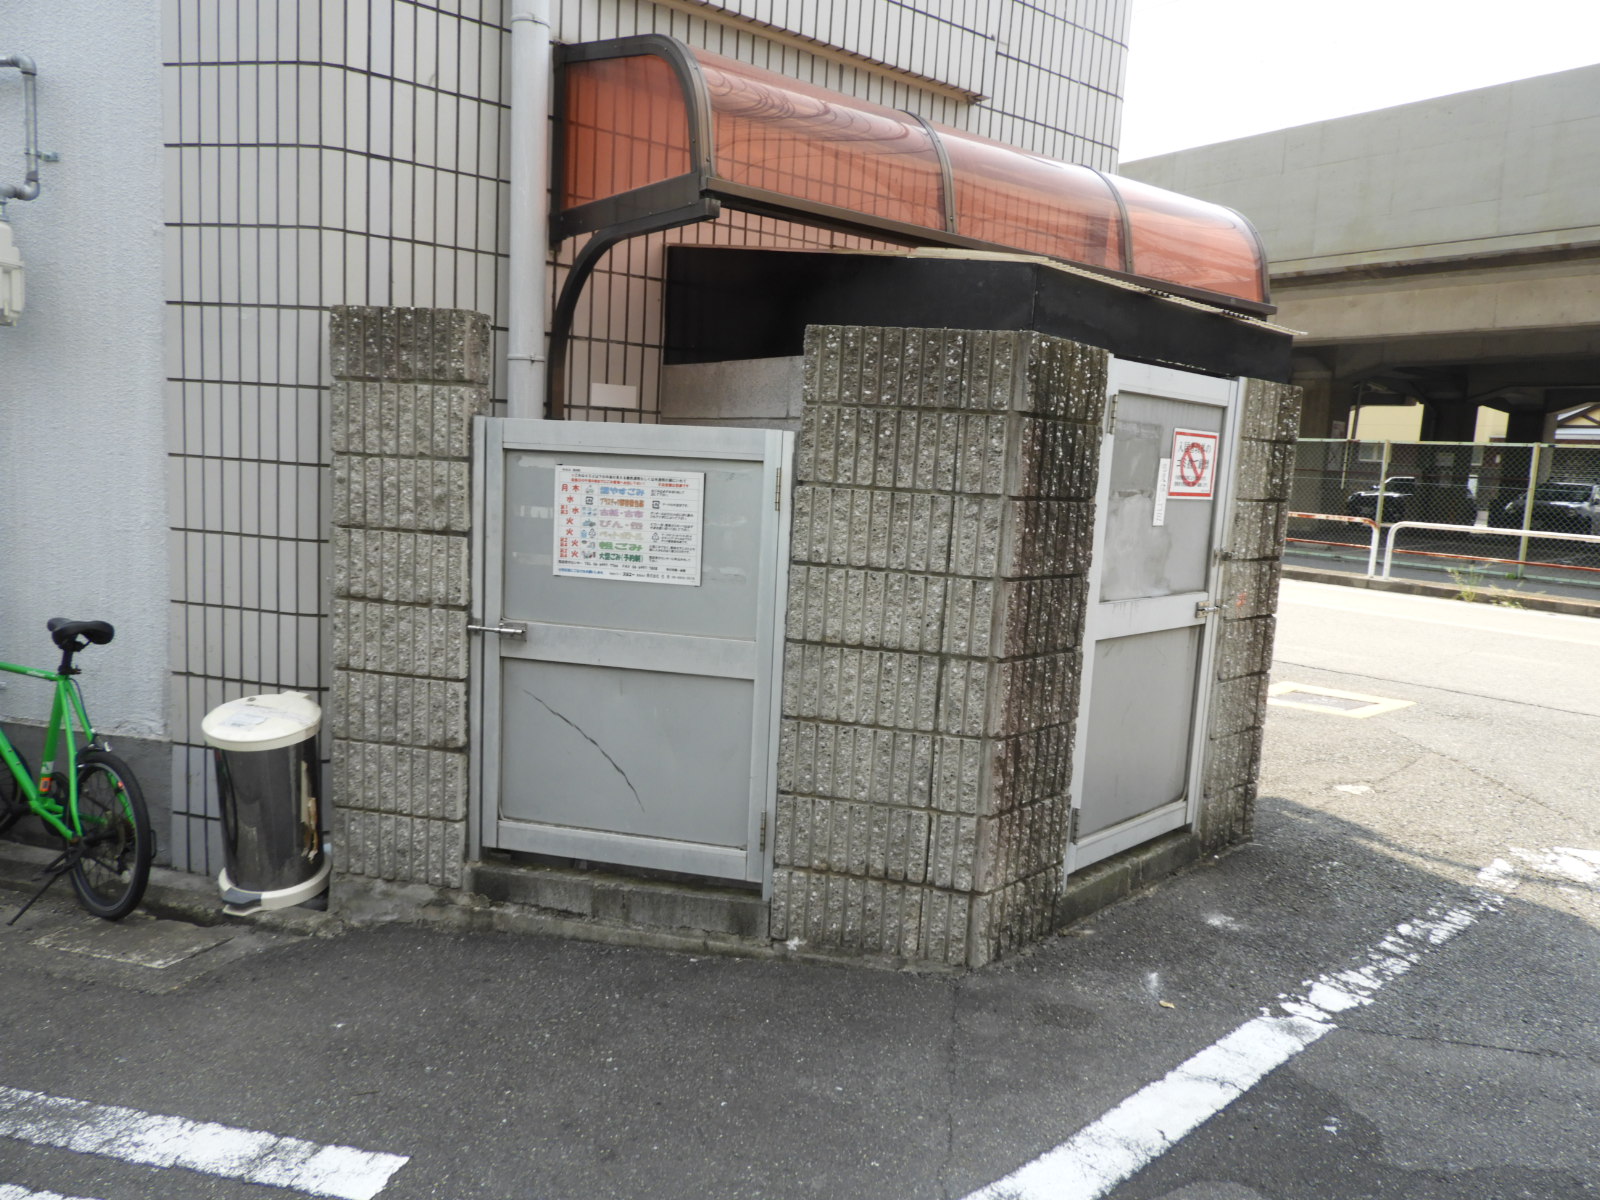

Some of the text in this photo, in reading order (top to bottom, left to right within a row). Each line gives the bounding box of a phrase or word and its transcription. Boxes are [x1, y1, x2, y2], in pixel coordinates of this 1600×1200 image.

[561, 484, 580, 492] 月 木
[566, 517, 574, 525] 火
[566, 528, 573, 536] 火
[571, 539, 579, 547] 火
[571, 550, 579, 558] 火
